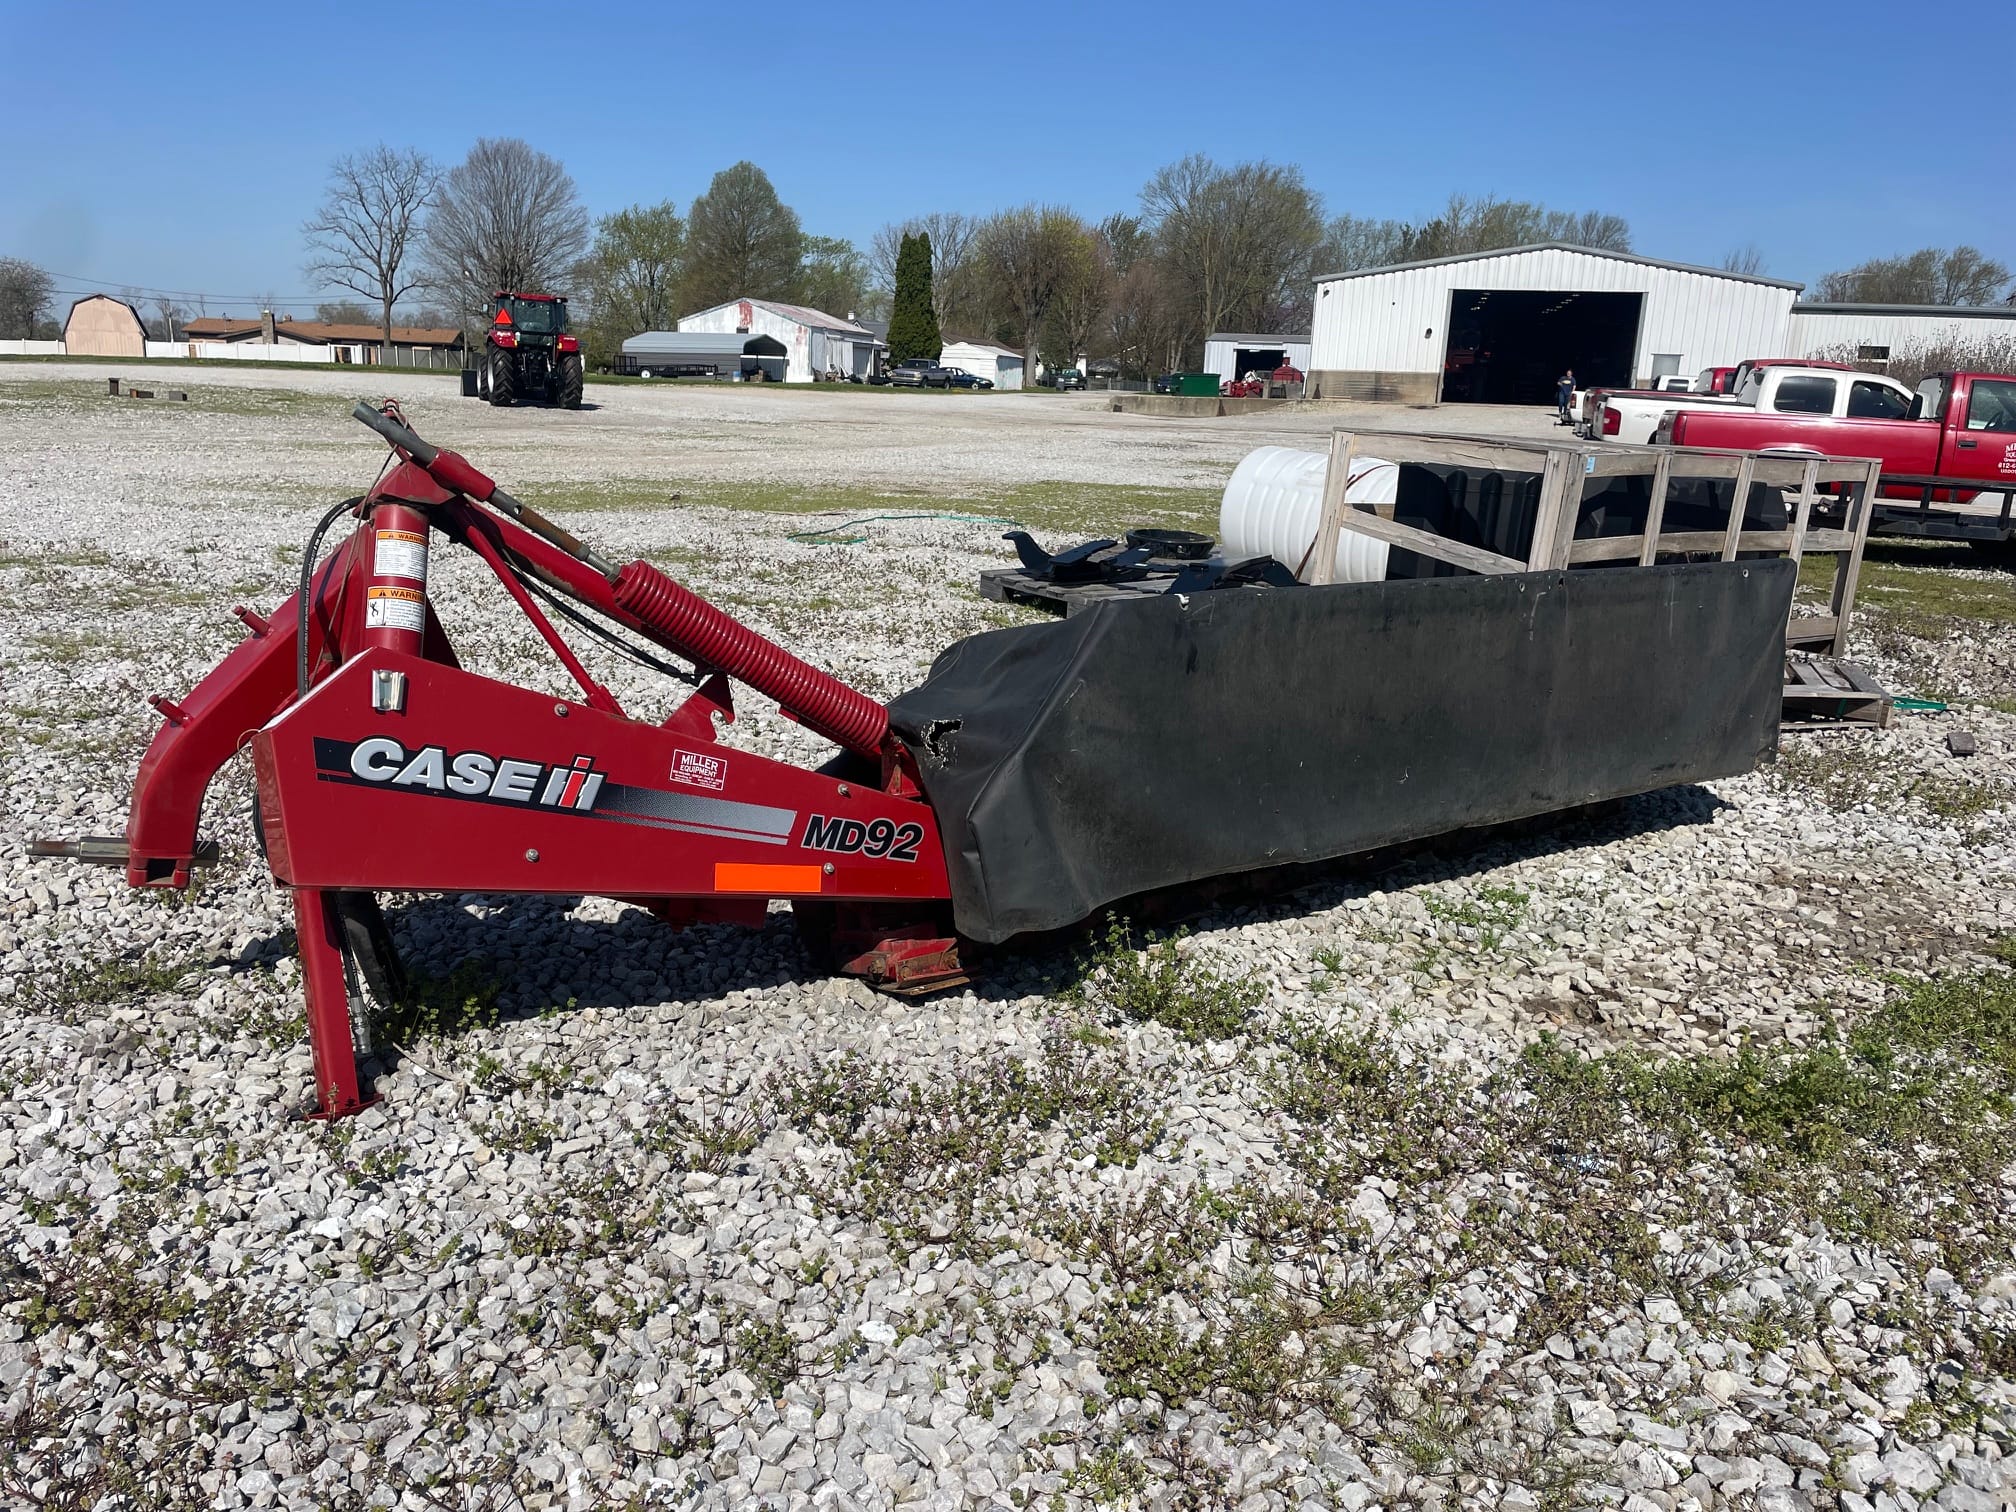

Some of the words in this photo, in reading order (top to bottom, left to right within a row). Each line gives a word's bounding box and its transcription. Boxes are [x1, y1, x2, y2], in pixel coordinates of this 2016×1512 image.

[350, 738, 543, 802] CASE
[679, 764, 718, 778] EQUIPMENT
[681, 754, 719, 772] MILLER
[800, 814, 924, 863] MD92
